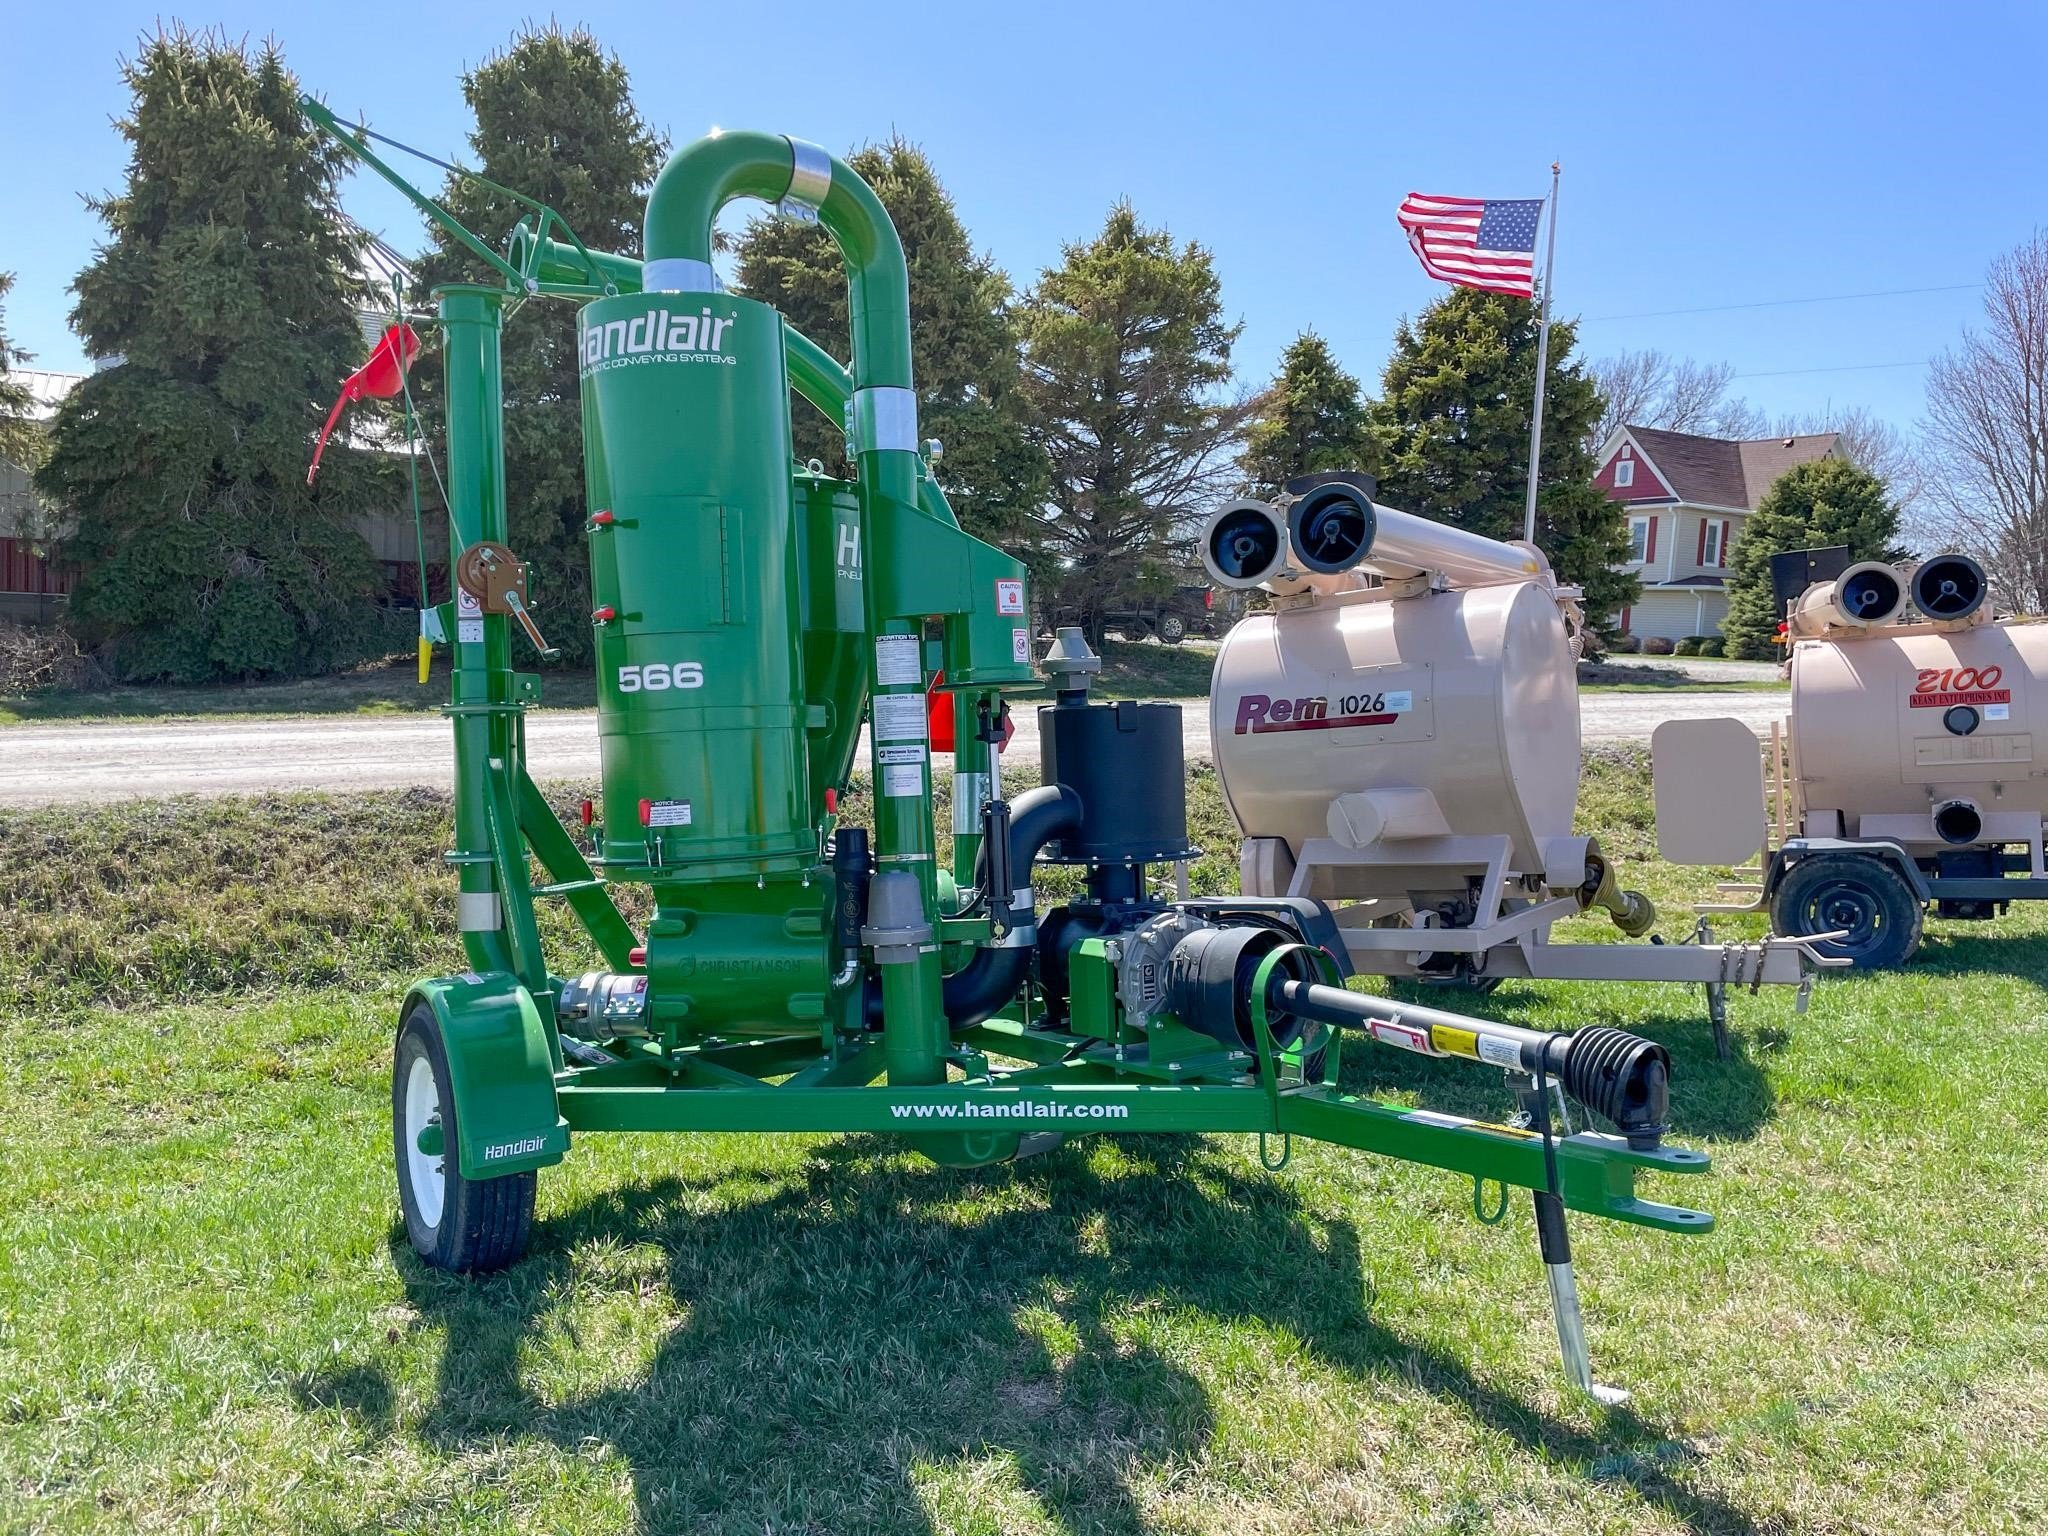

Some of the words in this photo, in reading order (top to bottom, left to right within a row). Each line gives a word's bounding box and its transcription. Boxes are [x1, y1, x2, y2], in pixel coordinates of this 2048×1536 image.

[611, 354, 677, 368] CONVEYING
[679, 354, 736, 365] SYSTEMS
[837, 523, 861, 567] H
[618, 662, 704, 693] 566
[1916, 666, 2002, 692] 2100
[1939, 691, 1992, 704] ENTERPRISES
[1235, 694, 1327, 735] Rem
[1339, 693, 1385, 715] 1026
[700, 959, 800, 973] CHRISTIANSON
[891, 1101, 1128, 1118] www.handlair.com
[485, 1136, 547, 1160] Handlair
